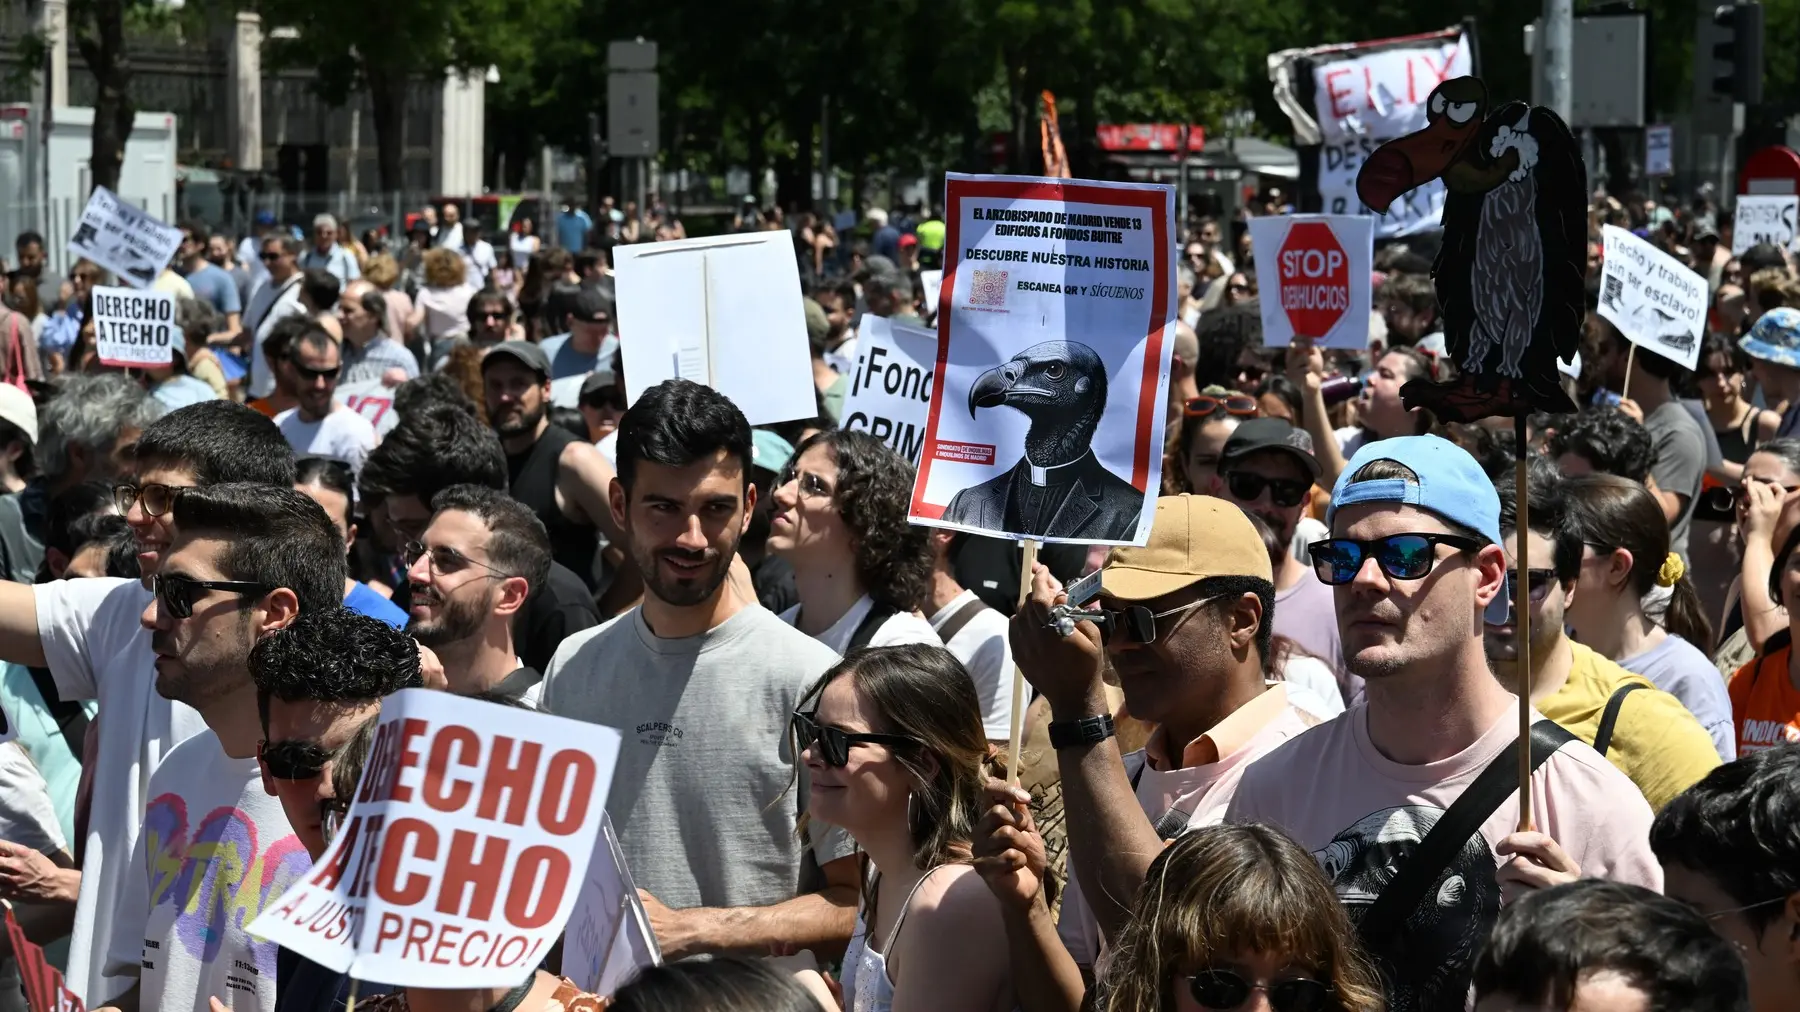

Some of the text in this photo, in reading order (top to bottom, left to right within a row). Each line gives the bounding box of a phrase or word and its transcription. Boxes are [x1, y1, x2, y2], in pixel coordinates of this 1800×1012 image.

[973, 208, 1142, 230] EL ARZOBISPADO DE MADRID VENDE 13
[995, 224, 1122, 244] EDIFICIOS A FONDOS BUITRE
[966, 248, 1150, 271] DESCUBRE NUESTRA HISTORIA
[1283, 249, 1343, 278] STOP
[1646, 263, 1656, 276] y
[1017, 281, 1145, 300] ESCANEA QR Y SÍGUENOS
[1606, 260, 1700, 324] sin ser esclavo!
[97, 294, 171, 321] DERECHO
[99, 320, 169, 347] A TECHO
[937, 443, 961, 452] SINDICATO
[636, 722, 672, 734] SCALPERS
[673, 728, 684, 738] CO
[311, 814, 572, 930] A TECHO
[270, 892, 309, 920] A
[374, 911, 544, 968] PRECIO!
